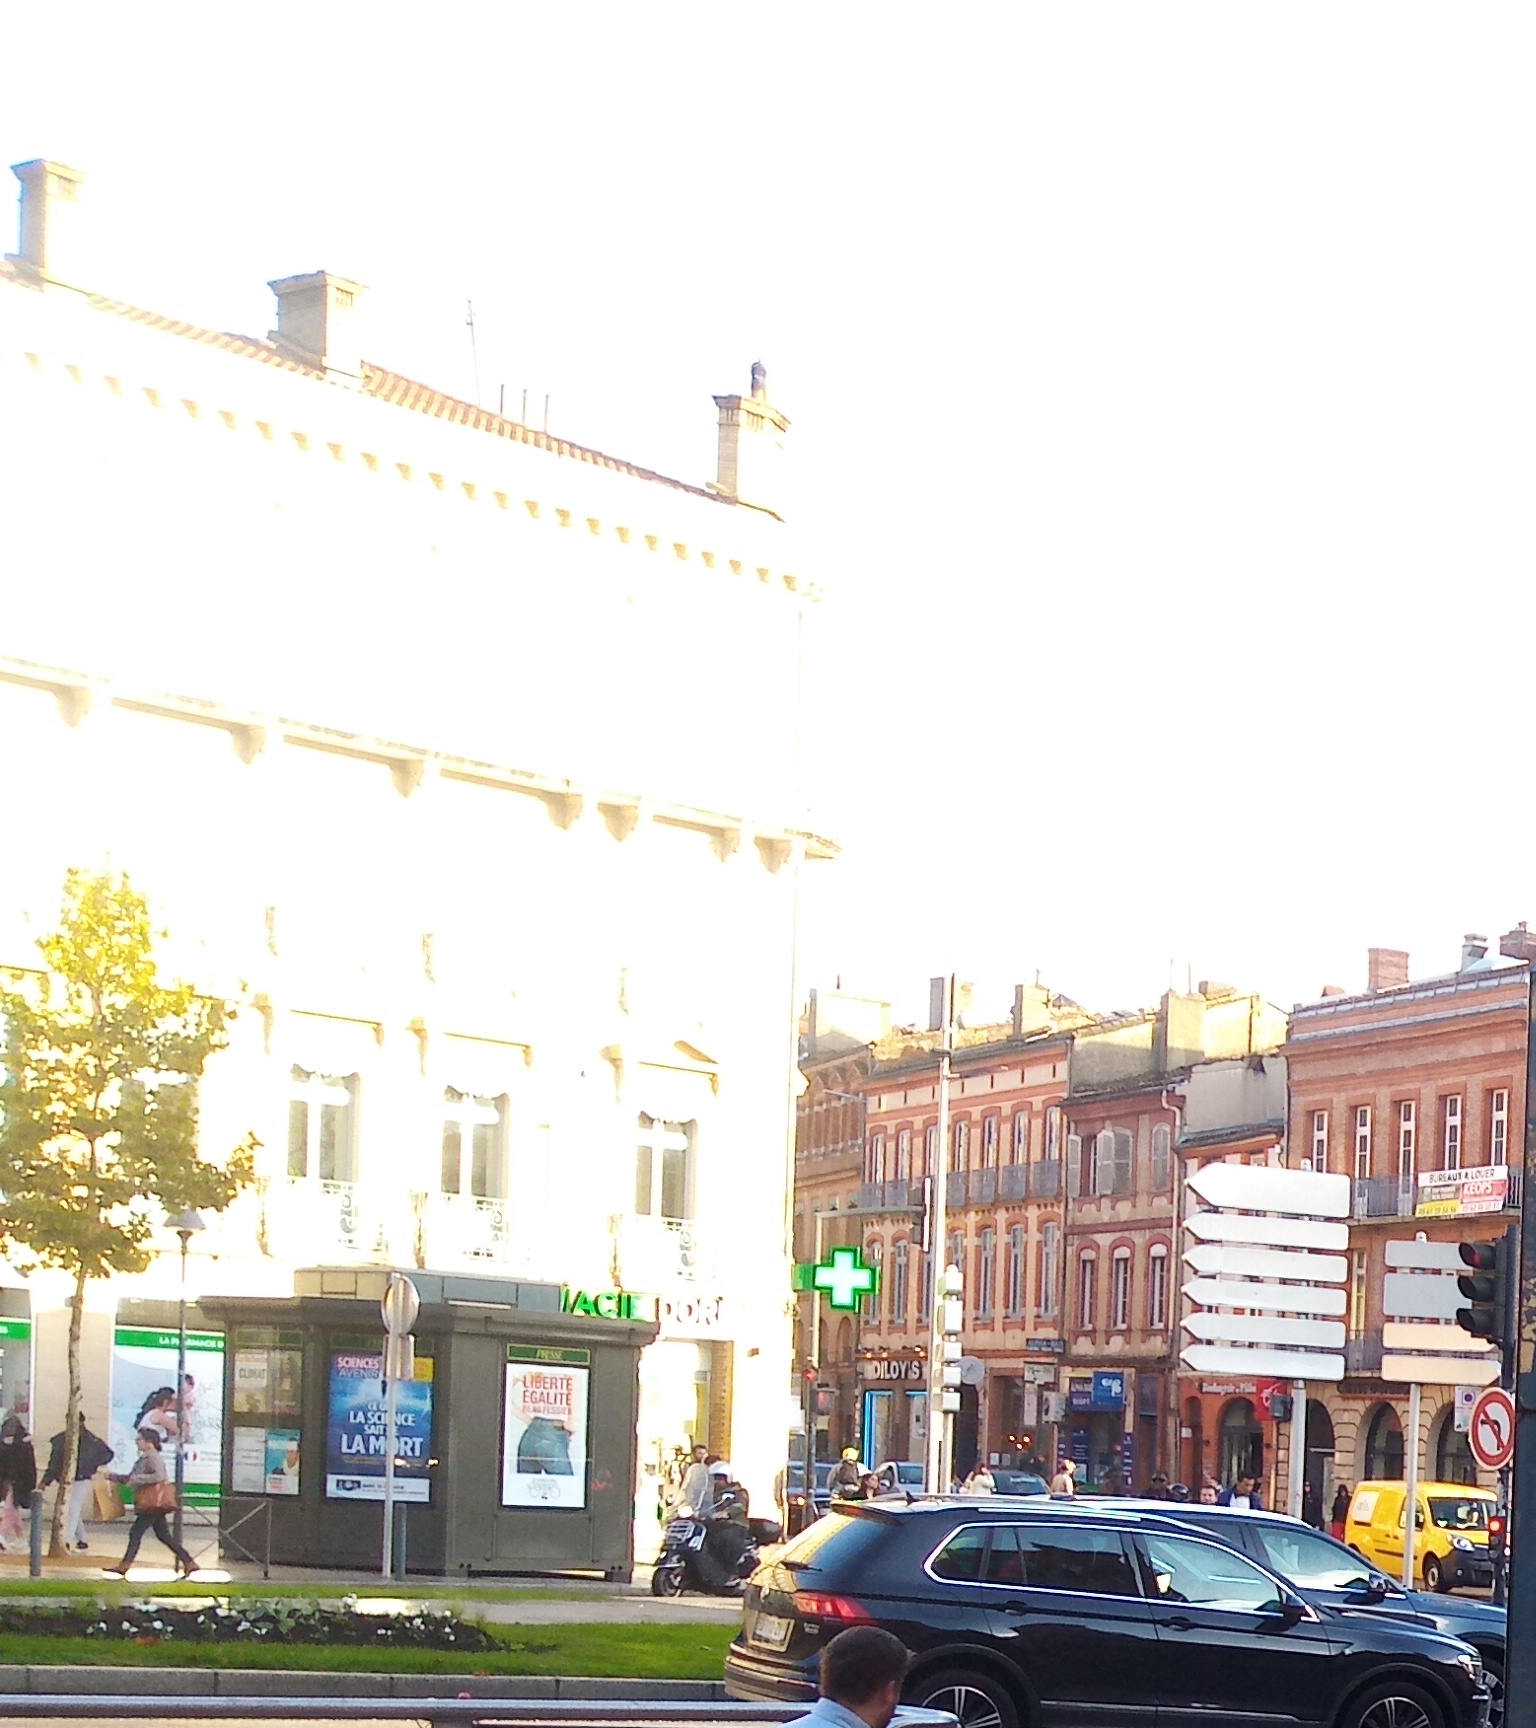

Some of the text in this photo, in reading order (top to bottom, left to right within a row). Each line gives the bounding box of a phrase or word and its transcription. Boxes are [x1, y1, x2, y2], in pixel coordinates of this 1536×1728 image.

[1429, 1171, 1462, 1184] BUREAUX
[1463, 1182, 1493, 1195] KEOPS
[336, 1355, 380, 1368] SCIENCES
[872, 1360, 921, 1380] DILOY'S
[349, 1410, 415, 1427] LA SCINCE
[341, 1433, 366, 1455] LA
